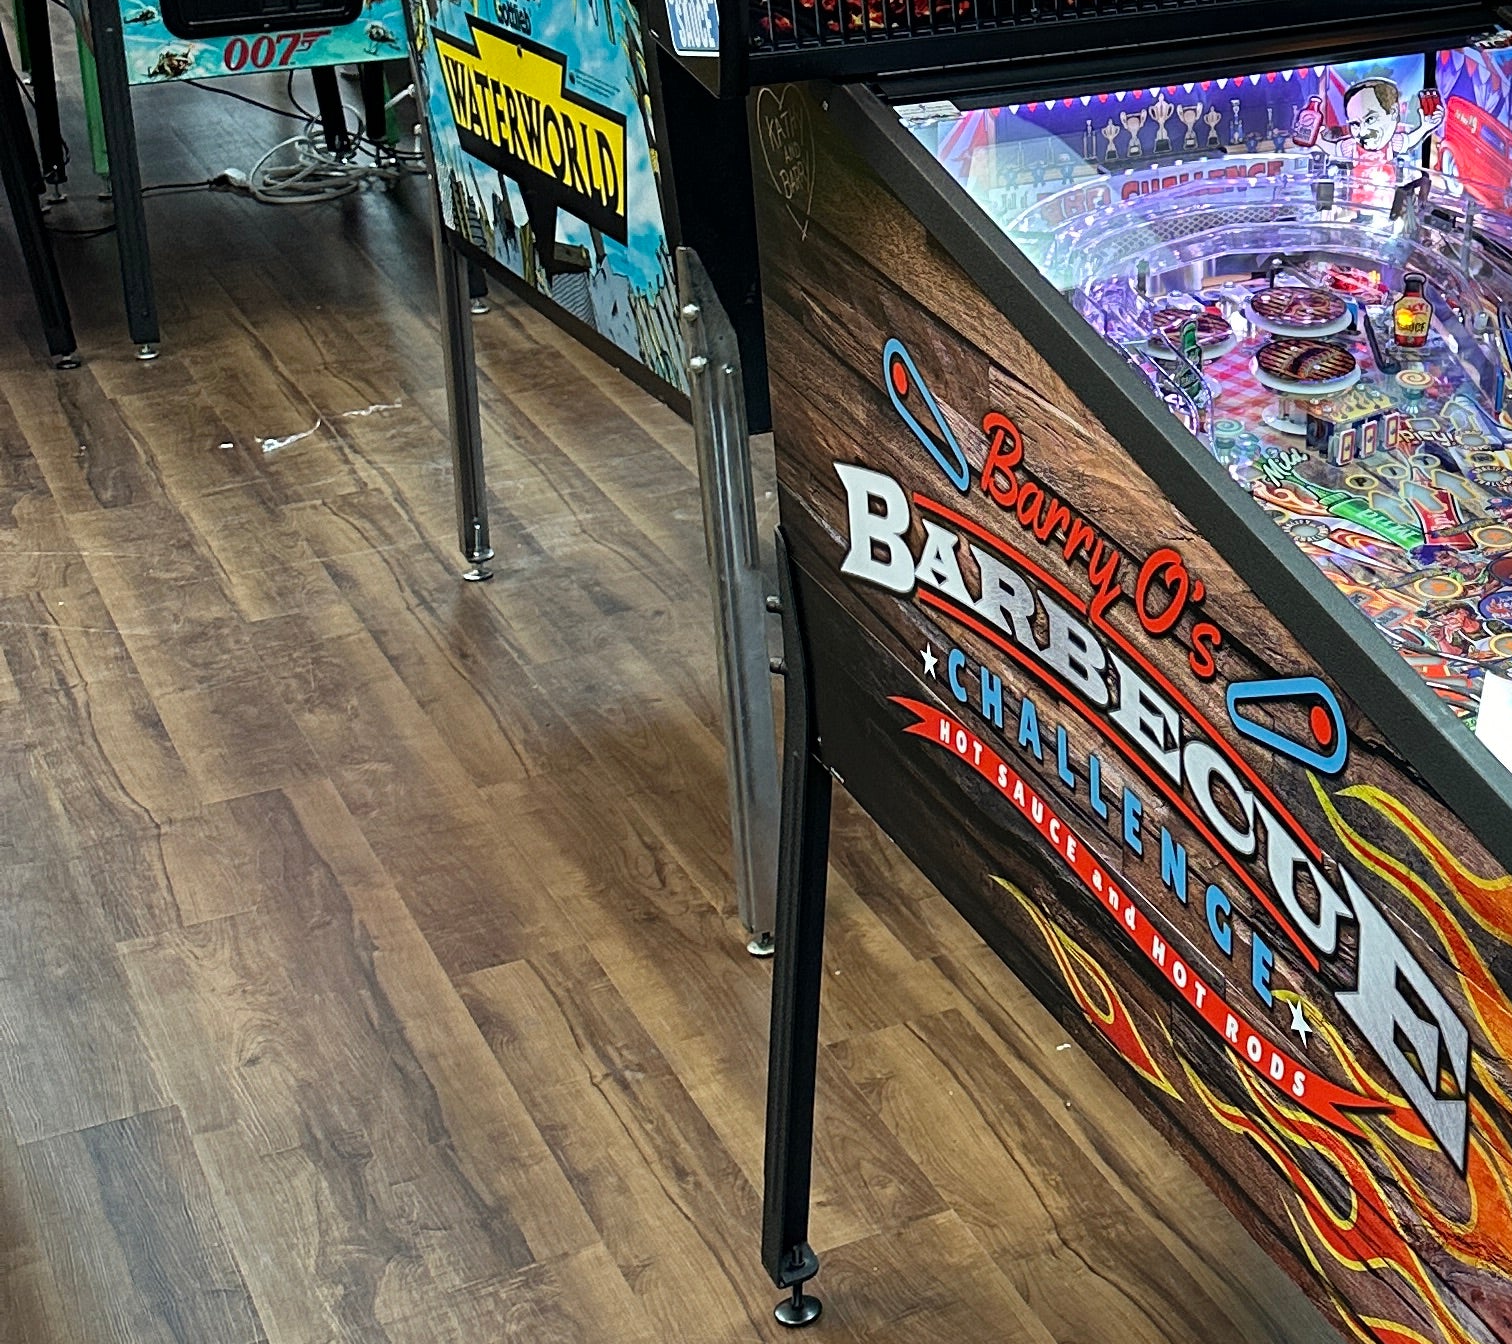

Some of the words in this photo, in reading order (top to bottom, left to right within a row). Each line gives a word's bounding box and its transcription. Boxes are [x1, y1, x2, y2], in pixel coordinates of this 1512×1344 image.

[224, 33, 306, 72] 007
[674, 2, 717, 48] SAUCE
[443, 54, 626, 217] WATERWORLD
[981, 411, 1123, 626] Barry
[1134, 548, 1224, 680] O's
[1262, 447, 1308, 488] Mild
[832, 460, 1471, 1179] BARBECUE
[938, 718, 985, 766] HOT
[994, 762, 1080, 864] SAUCE
[1091, 868, 1139, 933] and
[1149, 936, 1209, 1010] HOT
[1224, 1017, 1309, 1098] RODS
[945, 647, 1283, 1000] CHALLENGE
